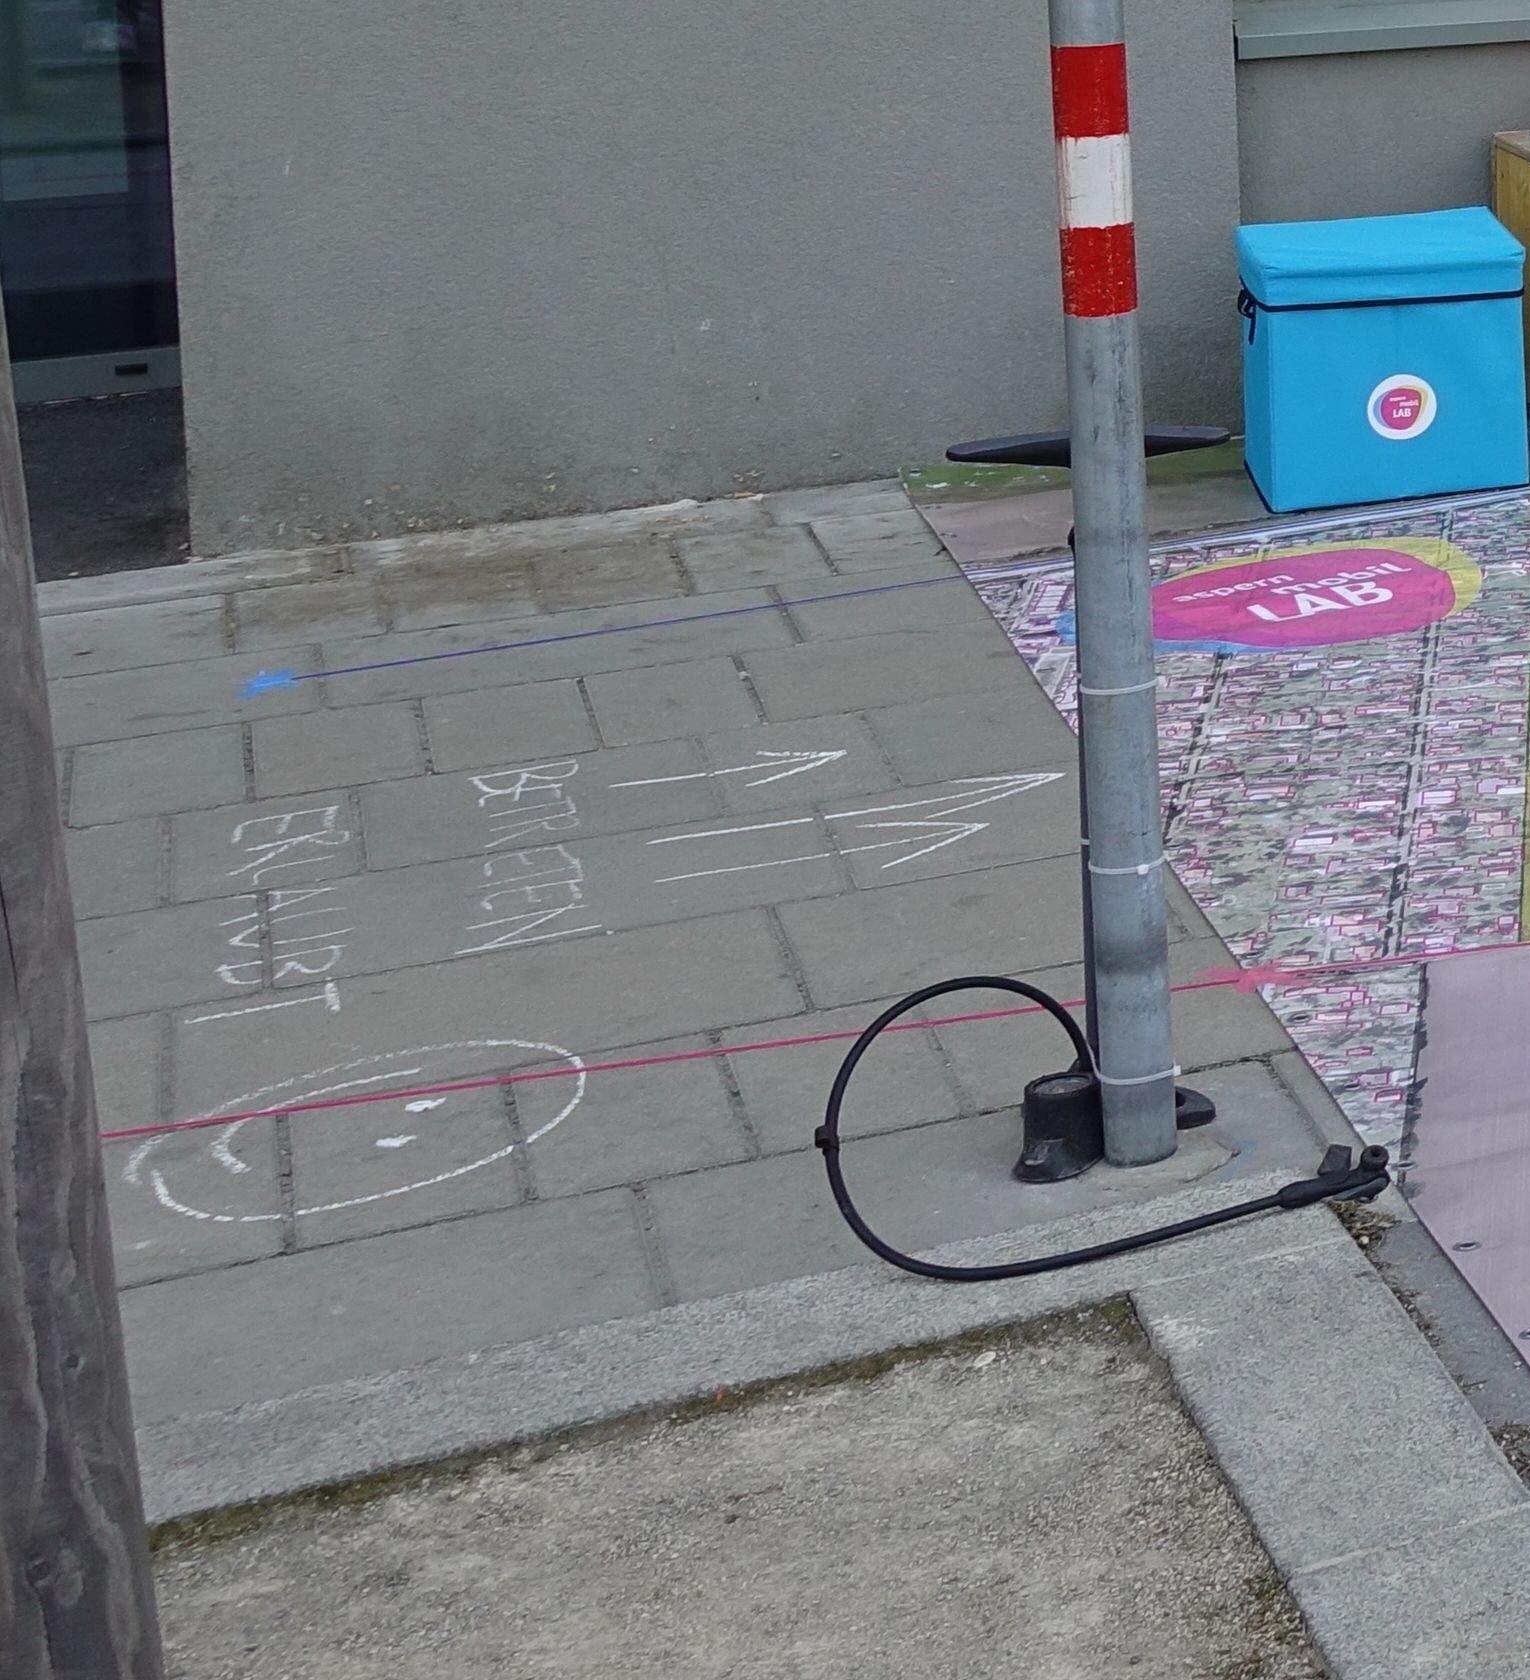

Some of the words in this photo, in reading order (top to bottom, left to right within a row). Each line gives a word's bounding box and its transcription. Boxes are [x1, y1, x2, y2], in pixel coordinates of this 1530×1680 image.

[1392, 408, 1411, 418] LAB
[1171, 574, 1295, 602] aspern
[1270, 562, 1413, 596] mobil
[1247, 581, 1394, 622] LAB
[454, 758, 602, 956] BETRETEN
